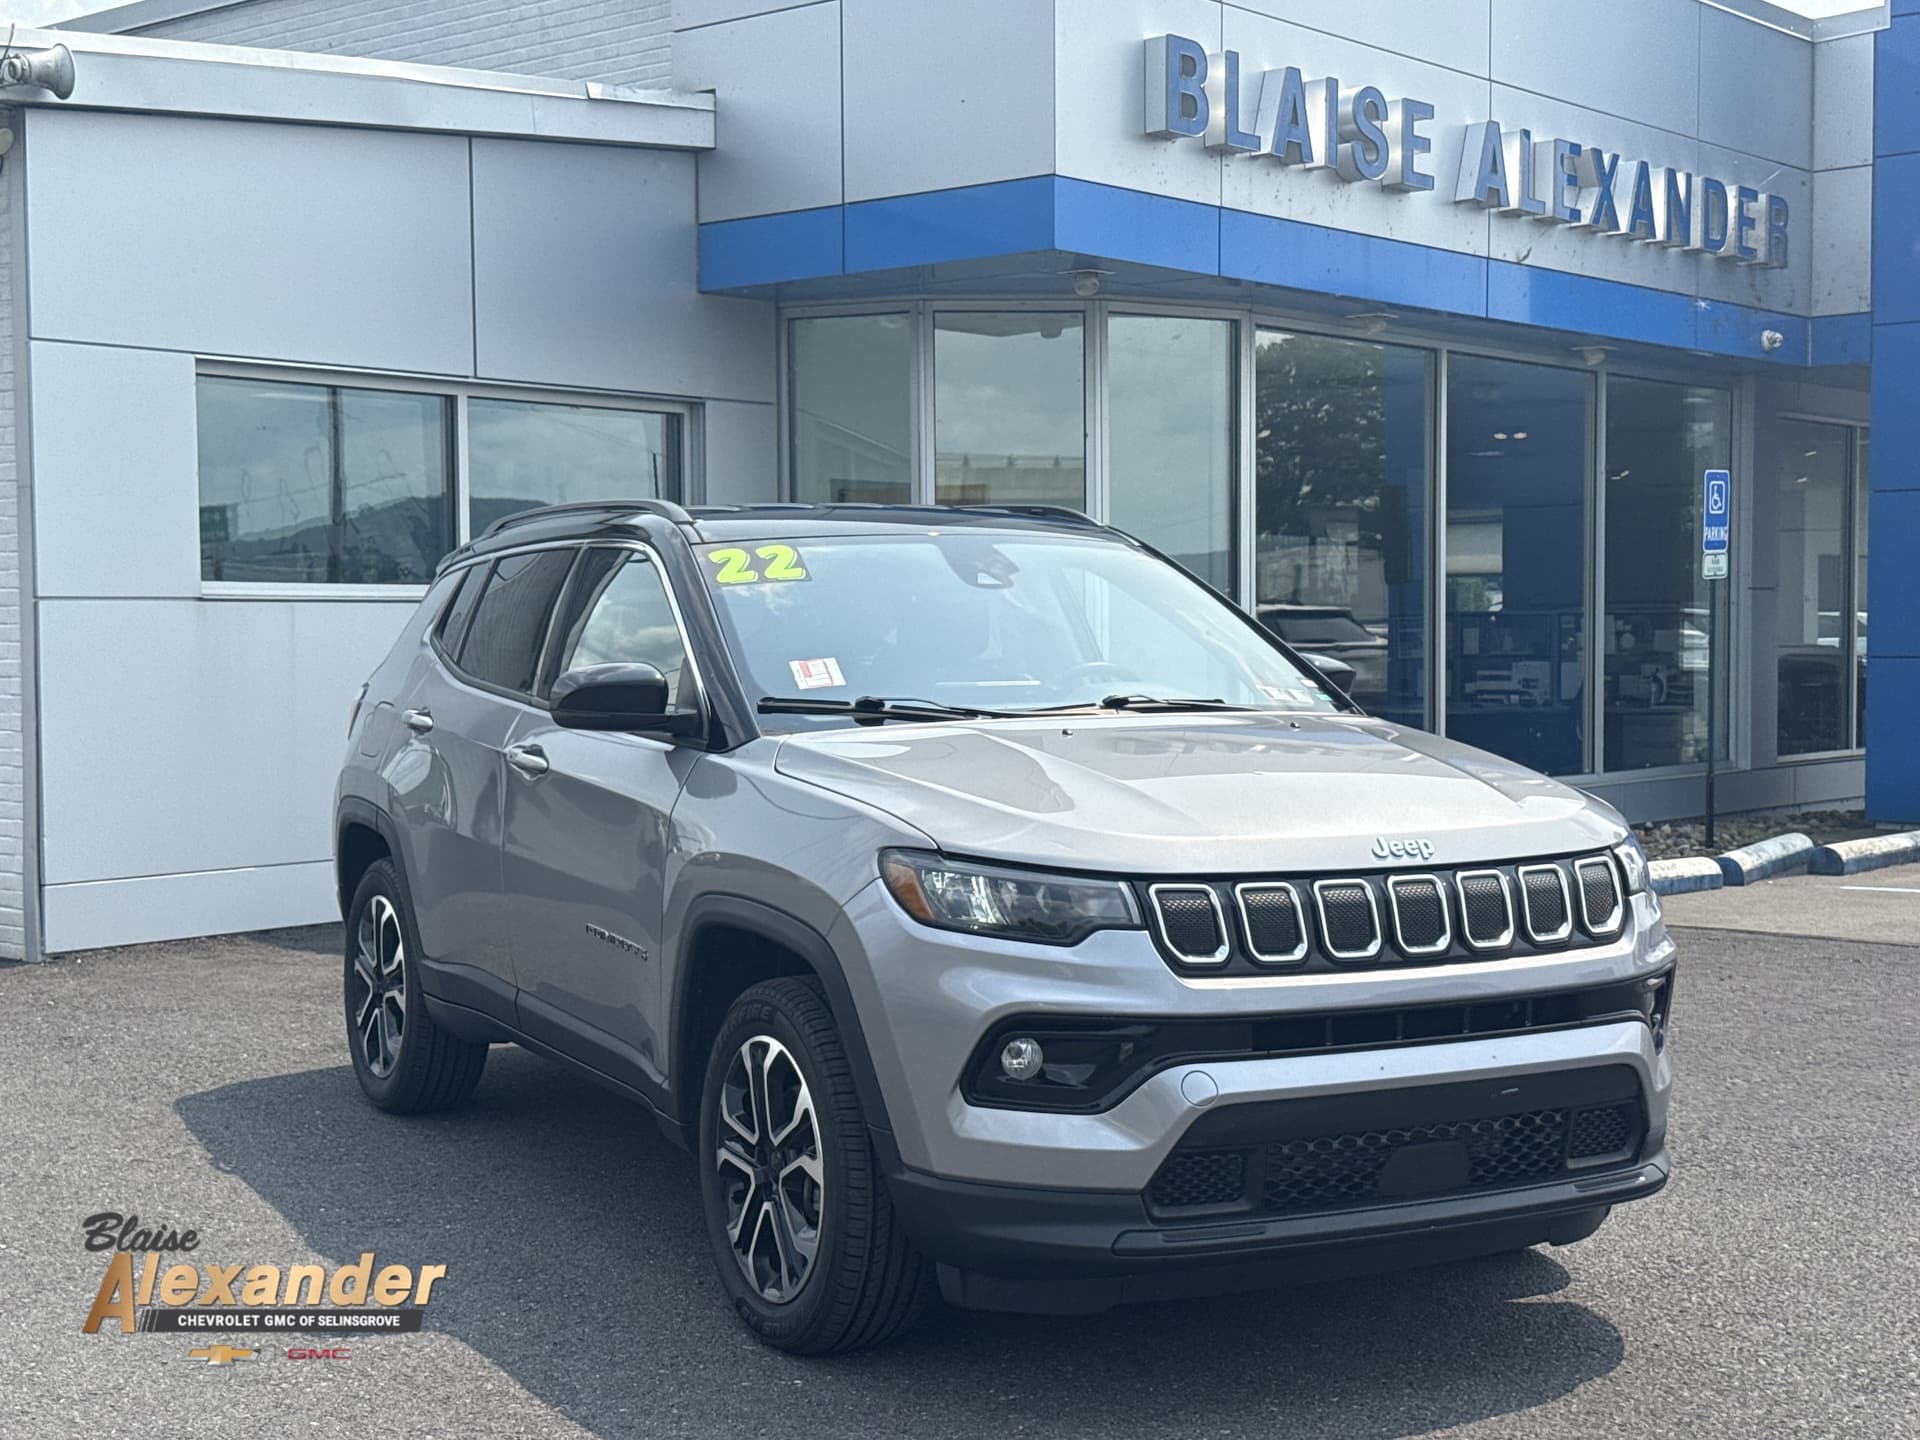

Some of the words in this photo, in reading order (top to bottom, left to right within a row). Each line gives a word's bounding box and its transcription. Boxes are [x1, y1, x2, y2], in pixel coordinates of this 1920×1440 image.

[1146, 34, 1435, 192] BLAISE
[1457, 119, 1790, 270] ALEXANDER
[1704, 526, 1728, 541] PARKING
[708, 544, 806, 585] 22
[1371, 836, 1435, 860] Jeep
